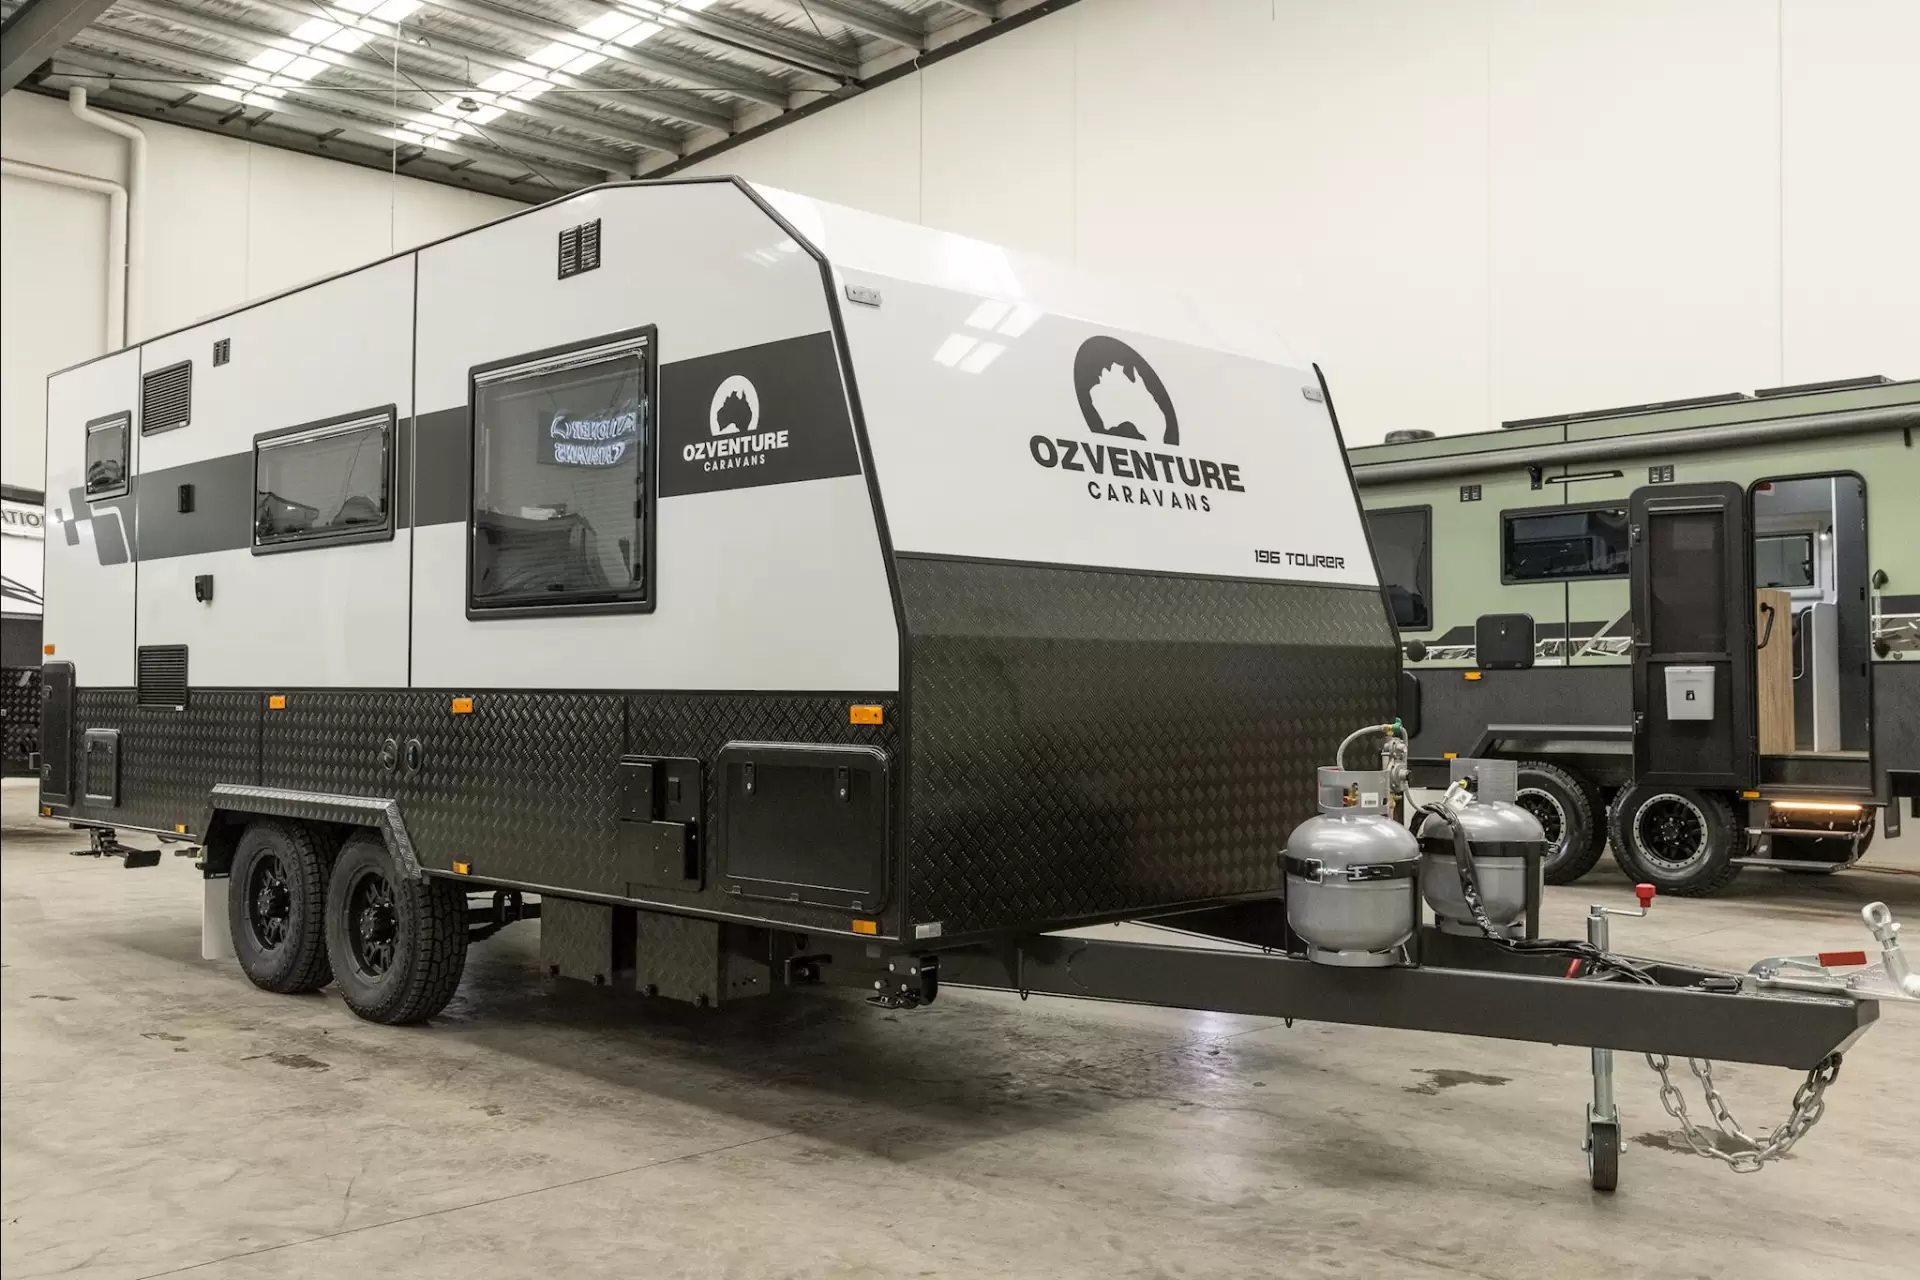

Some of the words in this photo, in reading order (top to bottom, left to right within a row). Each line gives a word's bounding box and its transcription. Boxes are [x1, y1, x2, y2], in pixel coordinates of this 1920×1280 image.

[683, 430, 789, 462] OZVENTURE
[703, 454, 765, 472] CARAVANS
[1029, 434, 1246, 493] OZVENTURE
[1087, 481, 1212, 513] CARAVANS
[1254, 549, 1280, 564] 196
